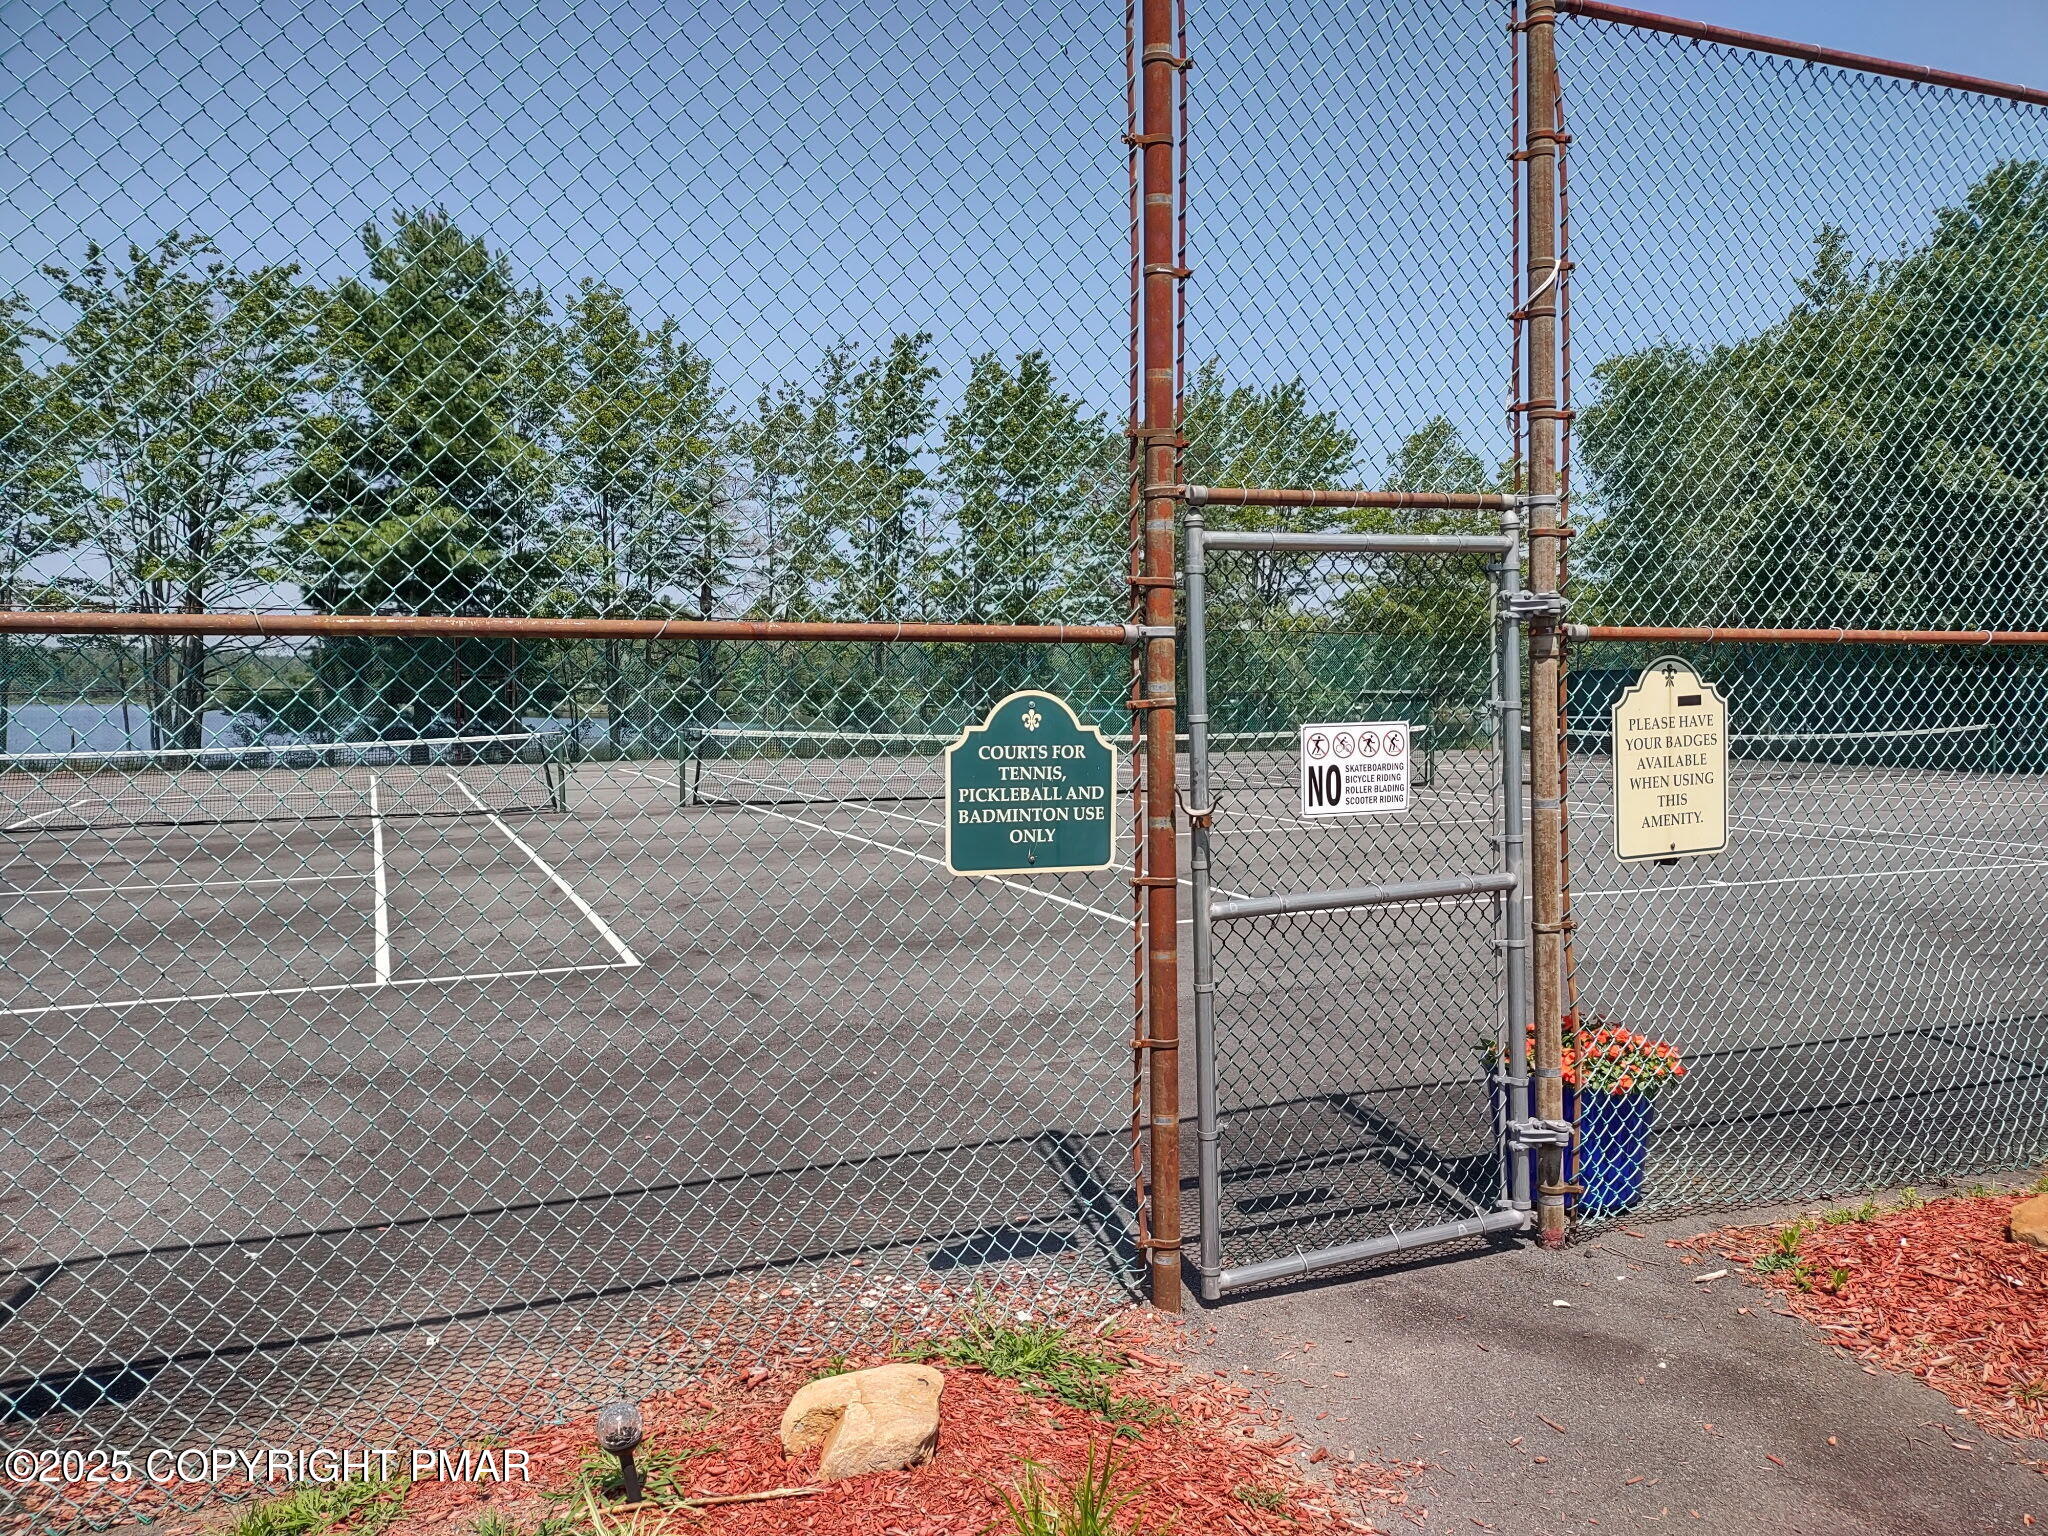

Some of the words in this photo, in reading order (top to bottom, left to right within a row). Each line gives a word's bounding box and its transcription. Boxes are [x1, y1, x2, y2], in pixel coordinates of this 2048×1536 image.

[1628, 716, 1676, 731] PLEASE
[1679, 714, 1714, 728] HAVE
[1625, 736, 1663, 751] YOUR
[1666, 733, 1718, 749] BADGES
[979, 745, 1048, 760] COURTS
[1051, 745, 1086, 759] FOR
[1345, 762, 1404, 773] SKATEBOARDING
[1637, 753, 1707, 770] AVAILABLE
[998, 766, 1067, 782] TENNIS,
[1345, 774, 1375, 784] BICYCLE
[1376, 773, 1401, 782] RIDING
[1630, 775, 1670, 790] WHEN
[1673, 772, 1714, 787] USING
[1308, 764, 1341, 807] NO
[1345, 785, 1373, 794] ROLLER
[1374, 784, 1405, 793] BLADING
[958, 787, 1063, 803] PICKLEBALL
[1066, 786, 1104, 800] AND
[1345, 796, 1378, 805] SCOOTER
[1379, 794, 1404, 803] RIDING
[1657, 793, 1688, 808] THIS
[958, 808, 1069, 823] BADMINTON
[1073, 807, 1105, 821] USE
[1641, 810, 1704, 829] AMENITY.
[1009, 828, 1056, 843] ONLY
